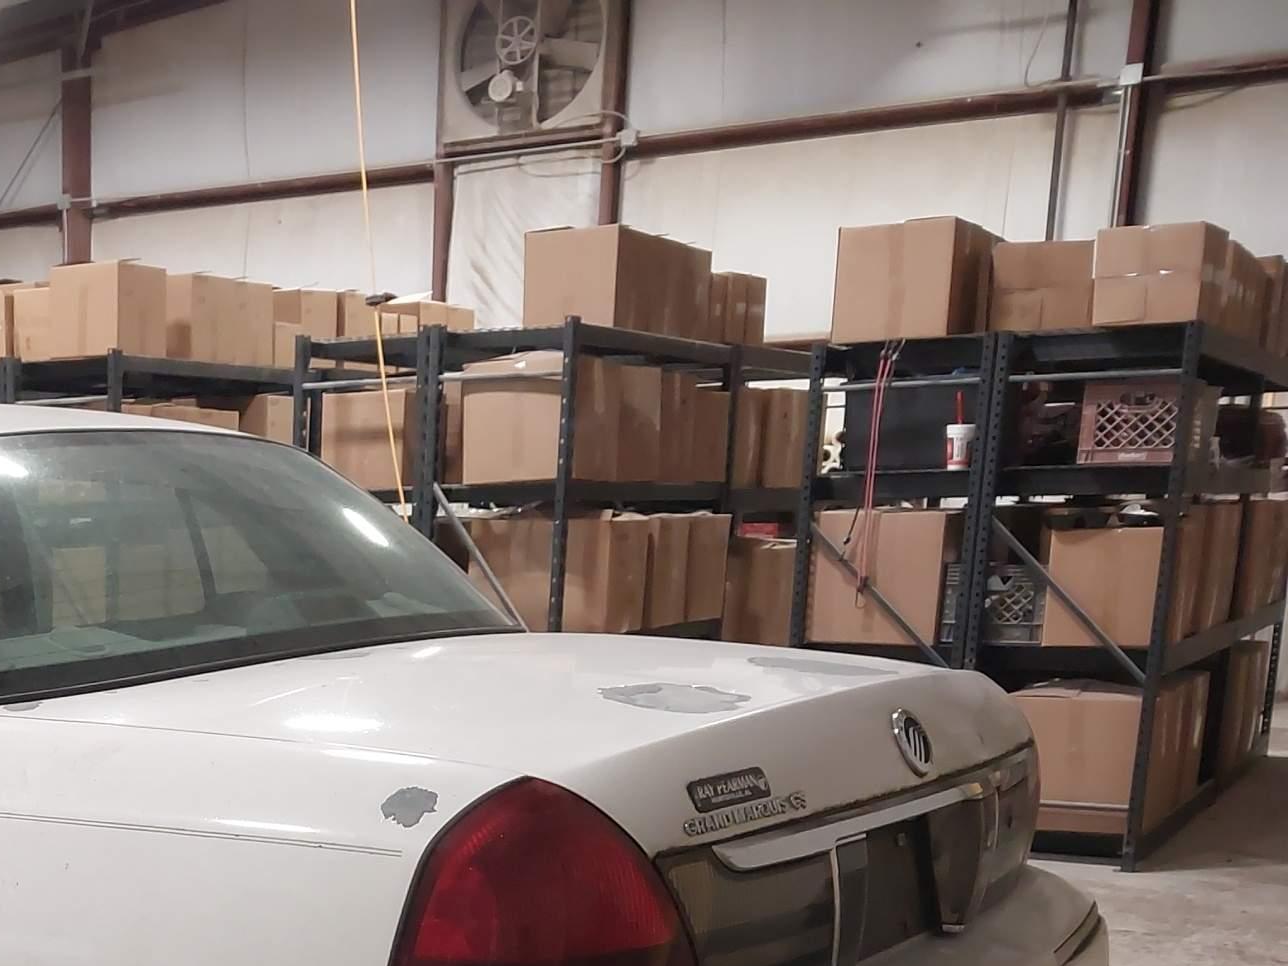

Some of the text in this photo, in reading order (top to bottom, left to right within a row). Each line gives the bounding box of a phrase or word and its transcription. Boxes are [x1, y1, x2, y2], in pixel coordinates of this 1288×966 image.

[697, 783, 715, 799] RAY
[684, 812, 732, 837] GRAND
[732, 798, 789, 824] MARQUIS
